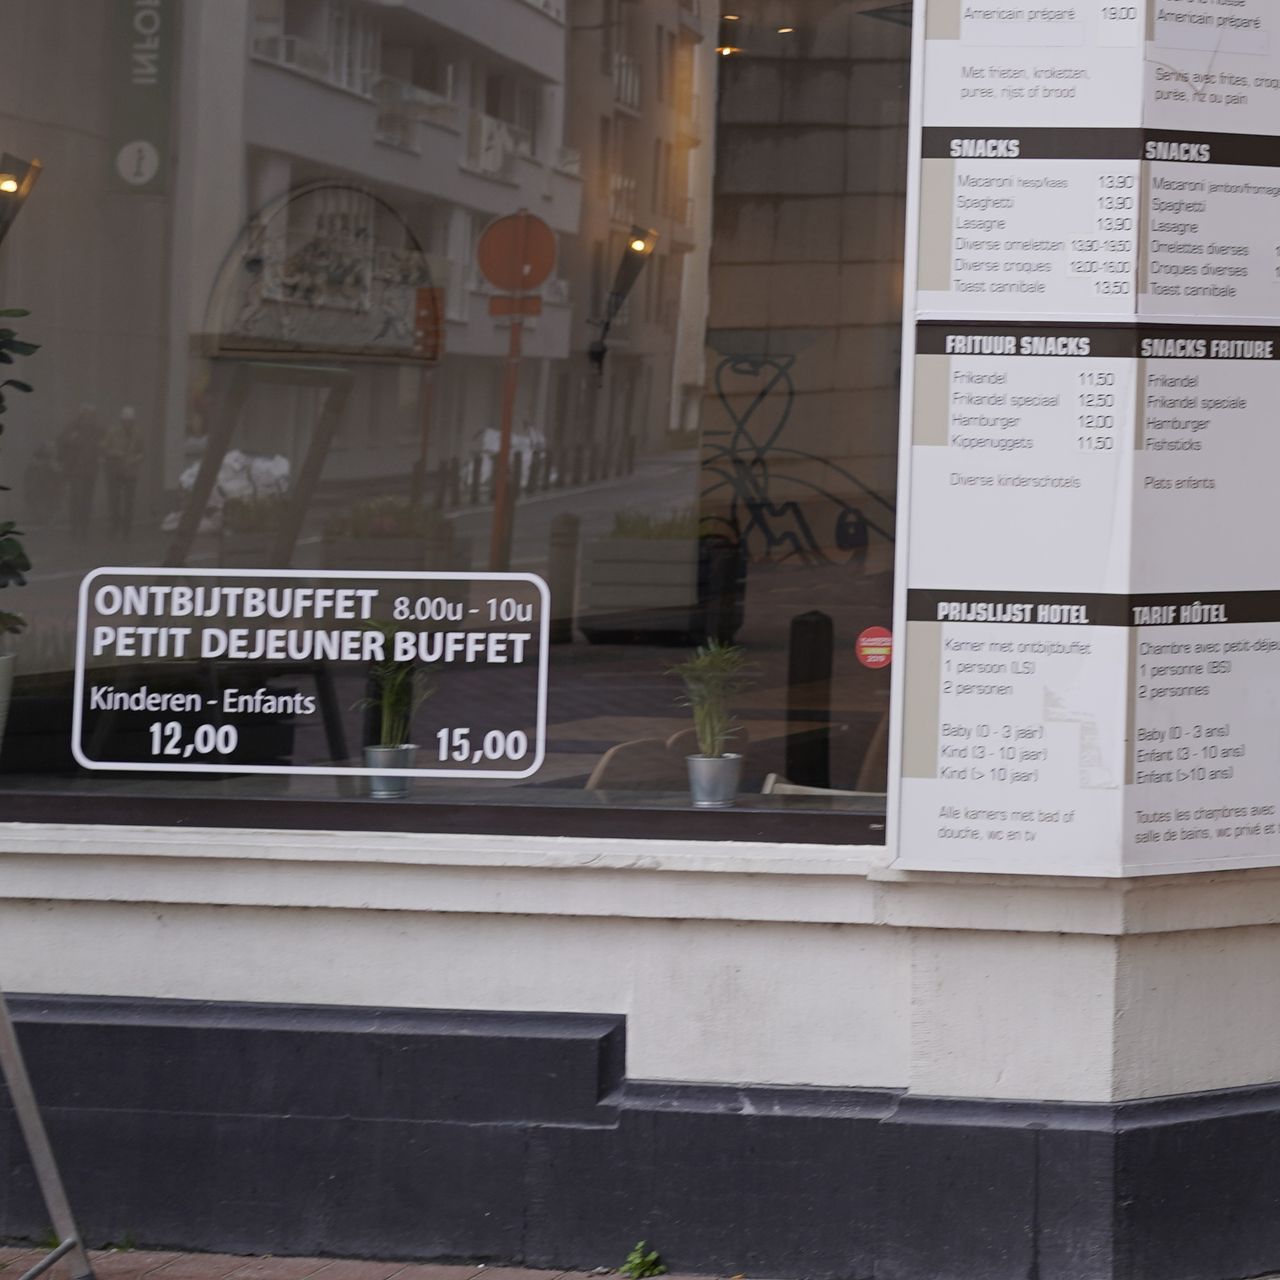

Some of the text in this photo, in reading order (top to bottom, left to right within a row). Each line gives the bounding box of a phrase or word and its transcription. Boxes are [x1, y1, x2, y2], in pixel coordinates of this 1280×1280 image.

[950, 139, 1020, 158] SNACKS
[1145, 141, 1210, 162] SNACKS
[946, 335, 1090, 355] FRITUUR SNACKS
[1141, 339, 1273, 358] SNACKS FRITURE
[94, 585, 378, 620] ONTBIJTBUFFET
[393, 595, 463, 622] 8.00u
[487, 598, 533, 623] 10u
[937, 602, 1089, 624] PRIJSLIJST HOTEL
[1132, 601, 1228, 625] TARIF HÔTEL
[93, 626, 531, 663] PETIT DEJEUNER BUFFET
[944, 681, 952, 694] 2
[90, 685, 201, 712] Kinderen
[223, 688, 316, 716] Enfants
[149, 721, 527, 764] 12,00 15,00
